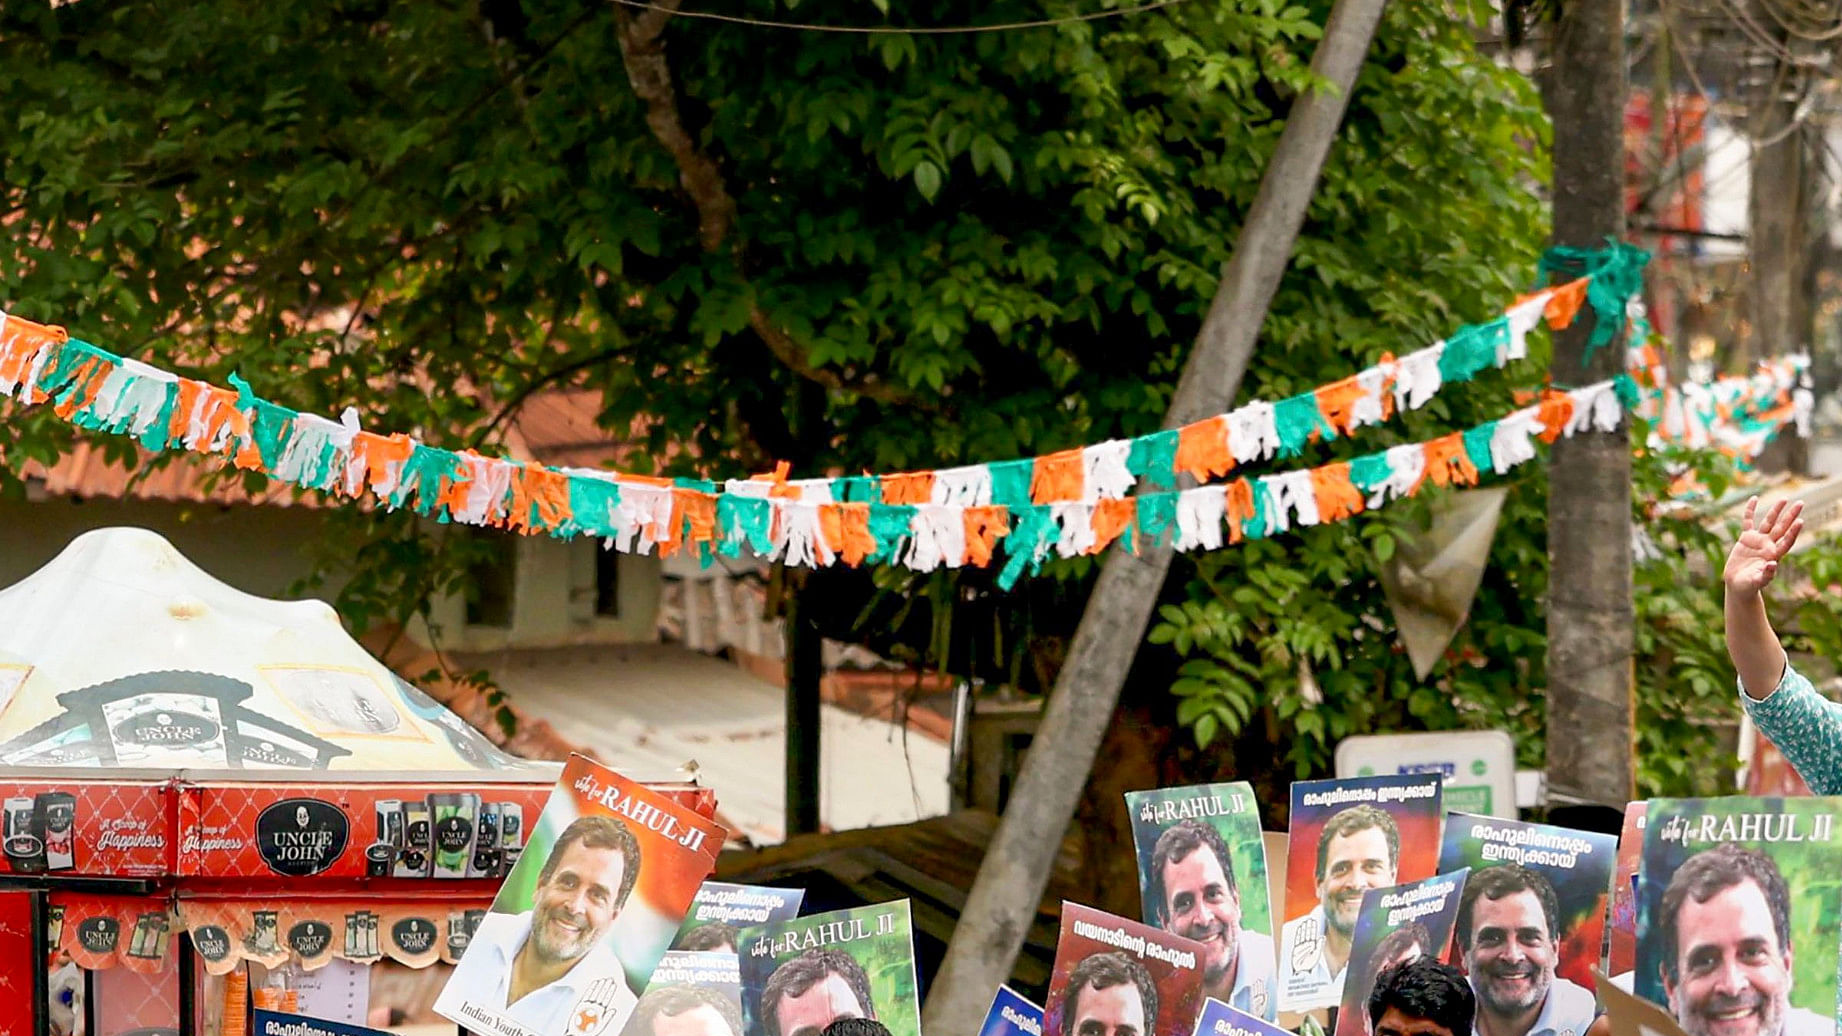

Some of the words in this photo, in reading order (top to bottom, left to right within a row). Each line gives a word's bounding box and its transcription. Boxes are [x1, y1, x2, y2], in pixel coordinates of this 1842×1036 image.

[574, 774, 590, 793] vote
[587, 782, 602, 801] for
[600, 783, 680, 847] RAHUL
[679, 827, 708, 852] JI
[1164, 795, 1230, 820] RAHUL
[1231, 793, 1245, 814] JI
[1661, 815, 1681, 843] vote
[1700, 813, 1804, 842] RAHUL
[1808, 813, 1833, 842] JI
[97, 830, 164, 850] Happiness
[183, 835, 243, 853] Happiness
[273, 831, 334, 846] UNCLE
[1470, 823, 1593, 856] രാഹുലിനൊപ്പം
[276, 846, 327, 861] JOHN
[1481, 842, 1578, 870] ഇന്ത്യക്കായ്
[85, 930, 116, 940] UNCLE
[199, 939, 224, 949] UNCLE
[296, 935, 325, 945] UNCLE
[400, 932, 431, 942] UNCLE
[402, 939, 427, 949] JOHN
[751, 937, 771, 957] vote
[770, 938, 785, 960] for
[784, 918, 872, 953] RAHUL
[876, 913, 895, 936] JI
[298, 942, 322, 951] JOHN
[1146, 942, 1197, 971] രാഹുൽ
[459, 1000, 492, 1028] Indian
